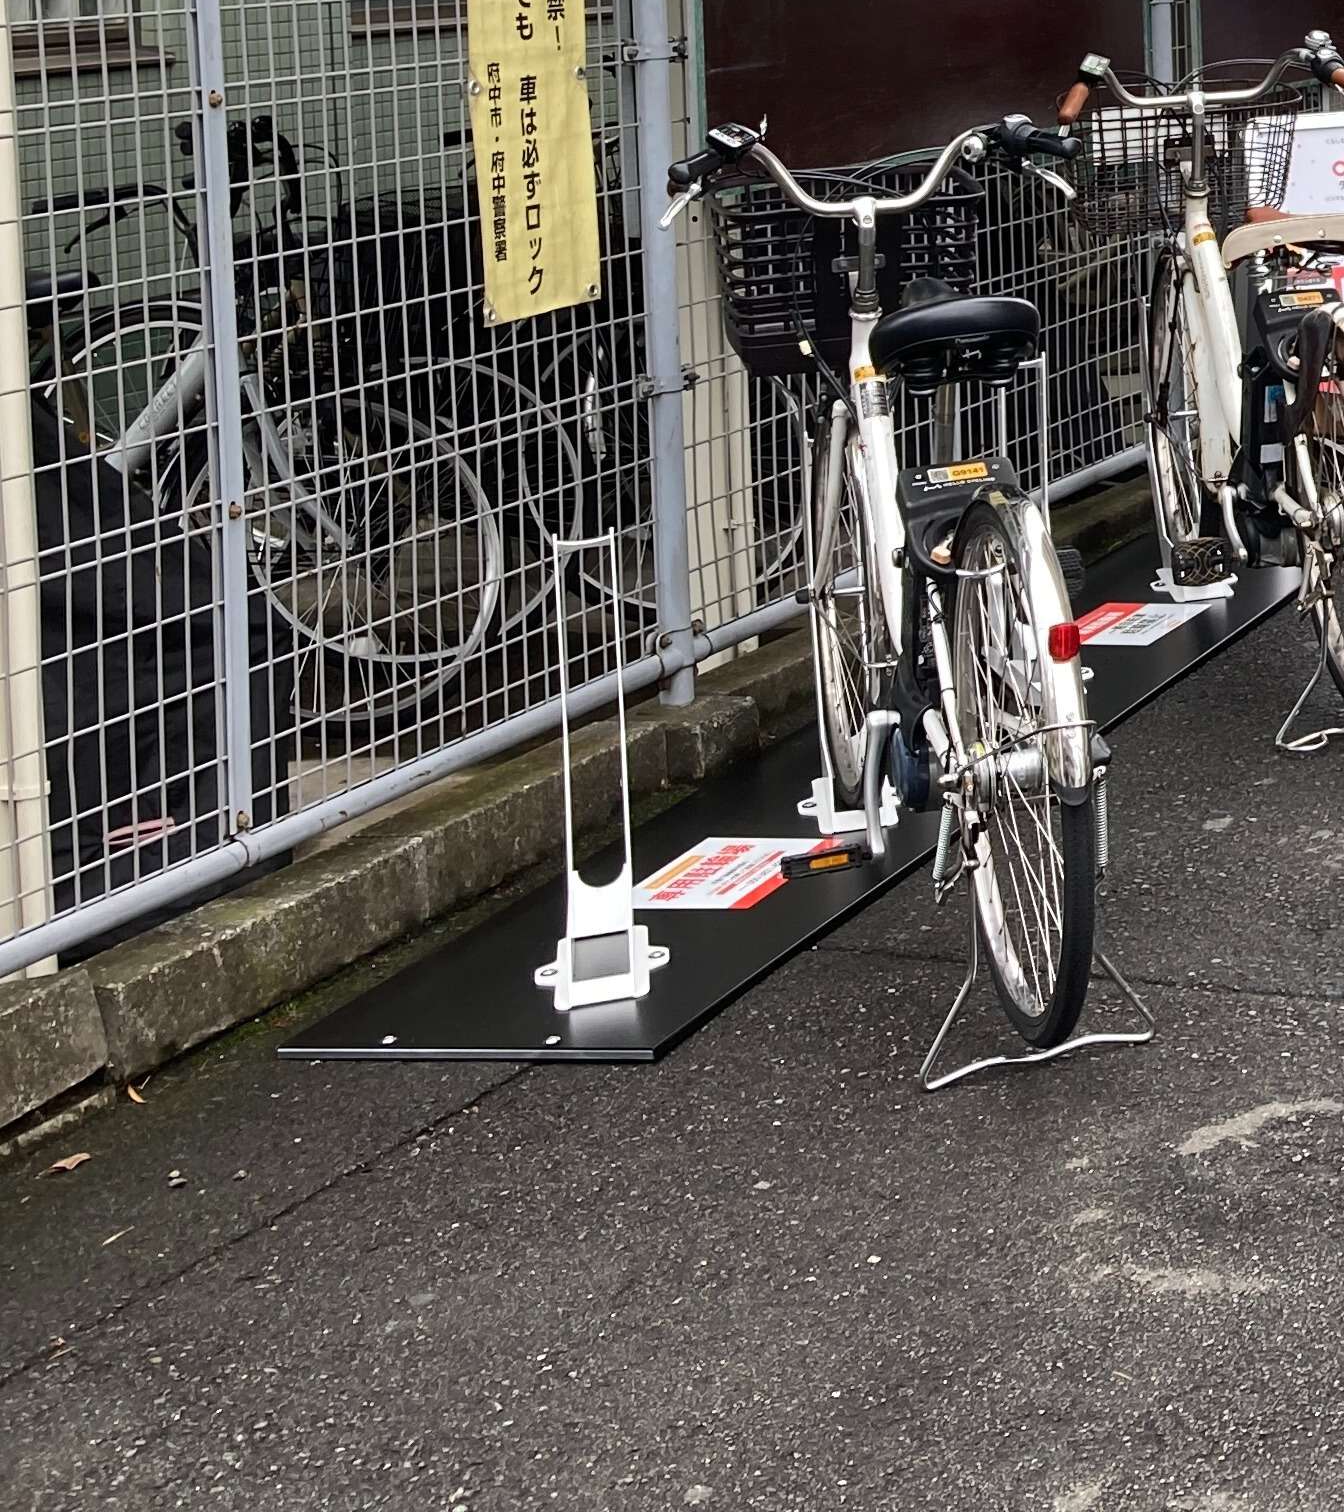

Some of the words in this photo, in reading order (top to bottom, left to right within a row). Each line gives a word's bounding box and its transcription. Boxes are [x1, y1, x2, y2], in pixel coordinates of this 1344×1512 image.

[487, 62, 508, 263] 府中市・府中警察署
[519, 74, 545, 296] 車は必ずロック
